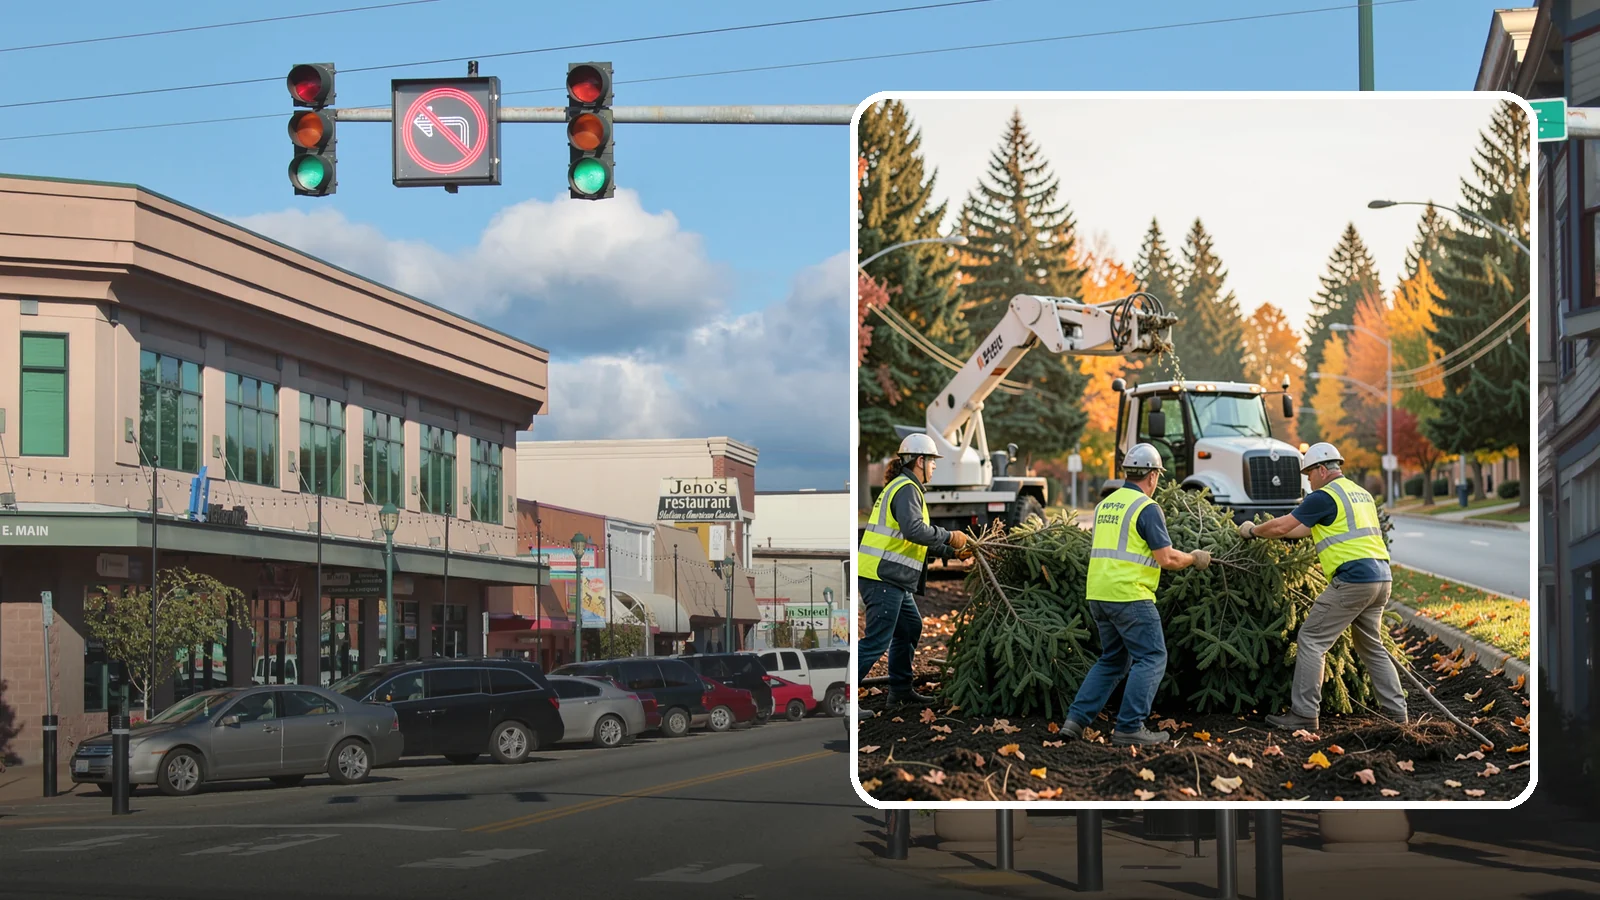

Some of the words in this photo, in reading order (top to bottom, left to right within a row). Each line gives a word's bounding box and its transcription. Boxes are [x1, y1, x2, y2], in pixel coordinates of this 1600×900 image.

[669, 480, 727, 495] Jeno's
[665, 496, 731, 509] restaurant
[658, 510, 681, 519] Italian
[686, 510, 715, 519] American
[715, 510, 737, 519] Cuisine
[2, 525, 13, 536] E.
[15, 525, 49, 536] MAIN
[797, 607, 828, 617] Street
[790, 619, 823, 627] lass
